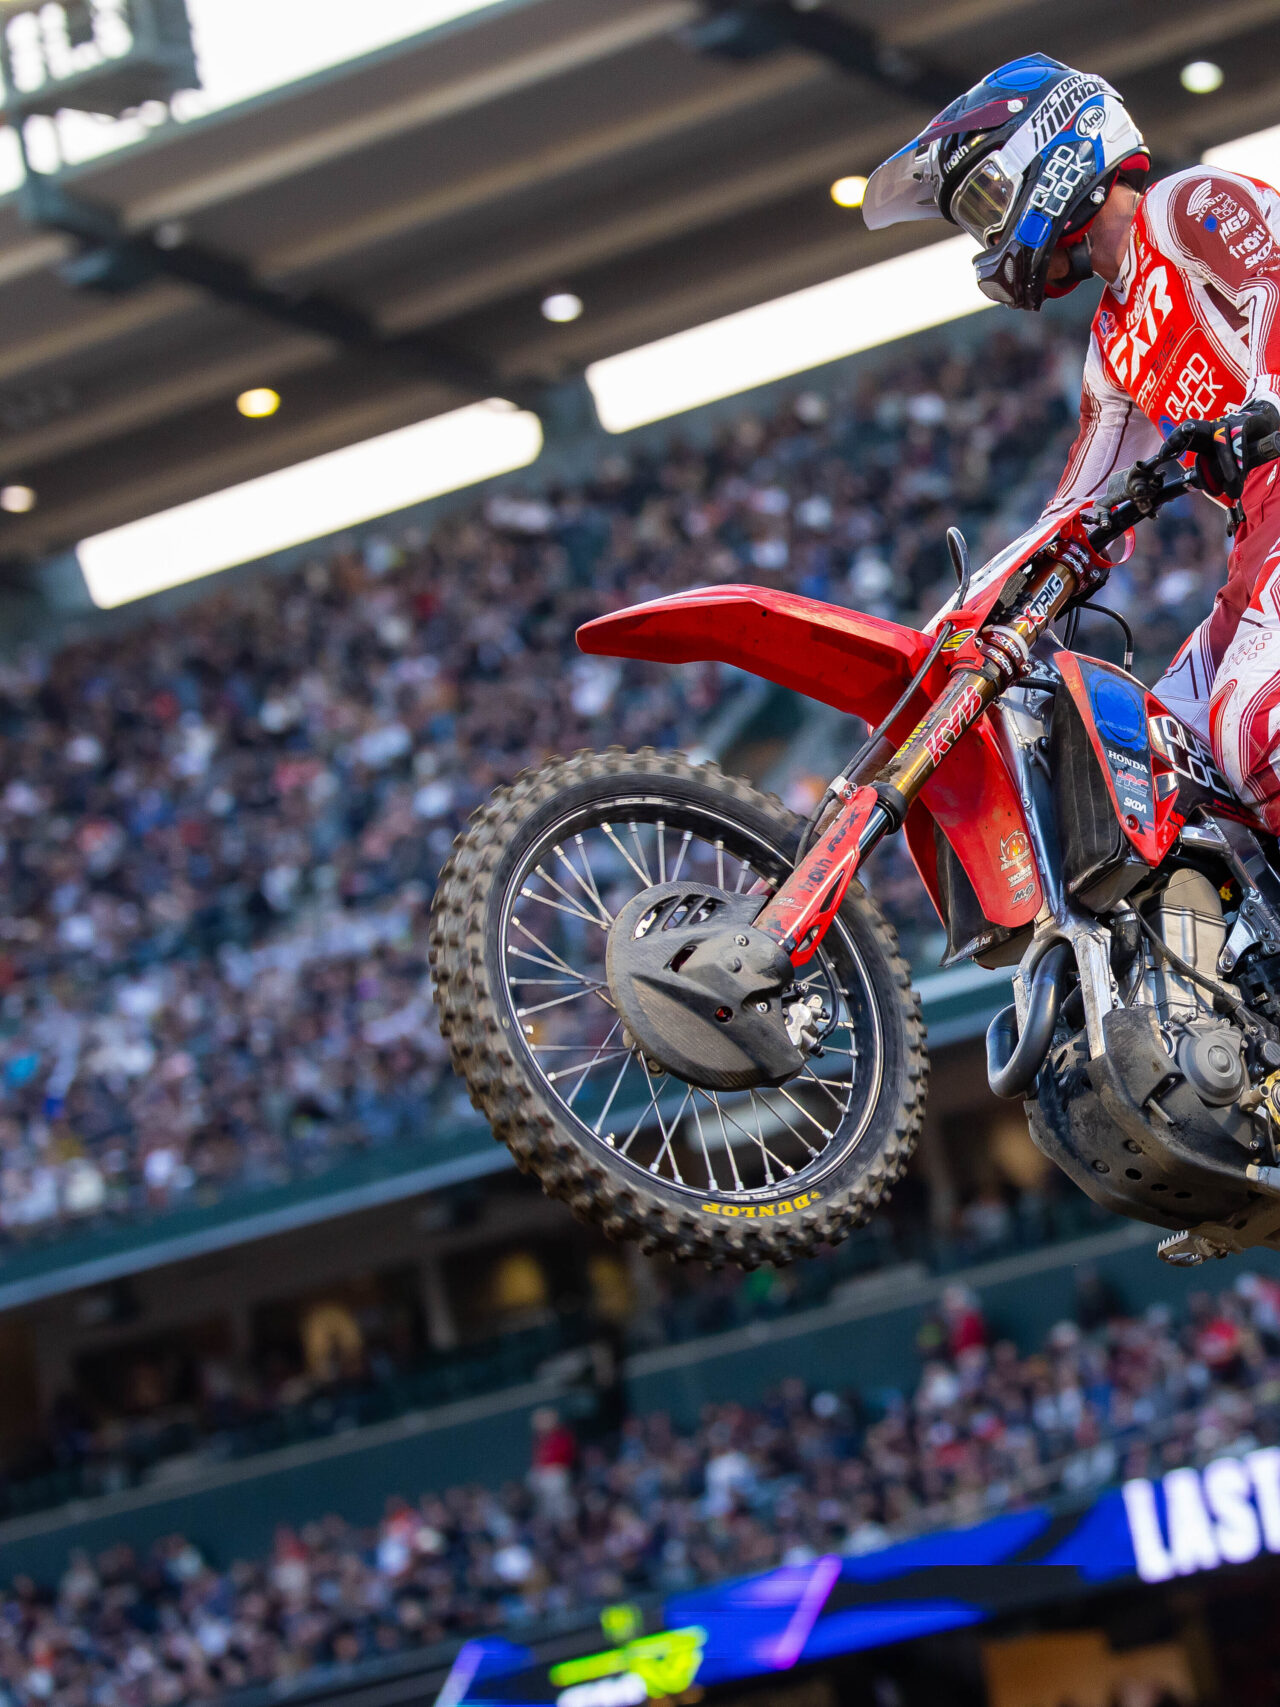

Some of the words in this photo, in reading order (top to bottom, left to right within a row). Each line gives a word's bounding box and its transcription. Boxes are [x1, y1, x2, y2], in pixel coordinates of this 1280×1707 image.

[1031, 75, 1082, 128] FACTORY
[1081, 109, 1103, 135] Arai
[1030, 145, 1074, 208] QUAD
[1044, 153, 1093, 217] LOCK
[1219, 207, 1250, 244] HGS
[1165, 352, 1209, 421] QUAD
[1186, 369, 1224, 421] OCK
[1014, 572, 1064, 633] XTRIG
[993, 632, 1021, 658] XTRIG
[923, 685, 982, 768] KYB
[1161, 716, 1216, 762] QUA
[1108, 750, 1149, 773] HONDA
[1166, 743, 1235, 800] LOC
[1123, 796, 1147, 814] SKDA
[701, 1193, 812, 1218] DUNLOP
